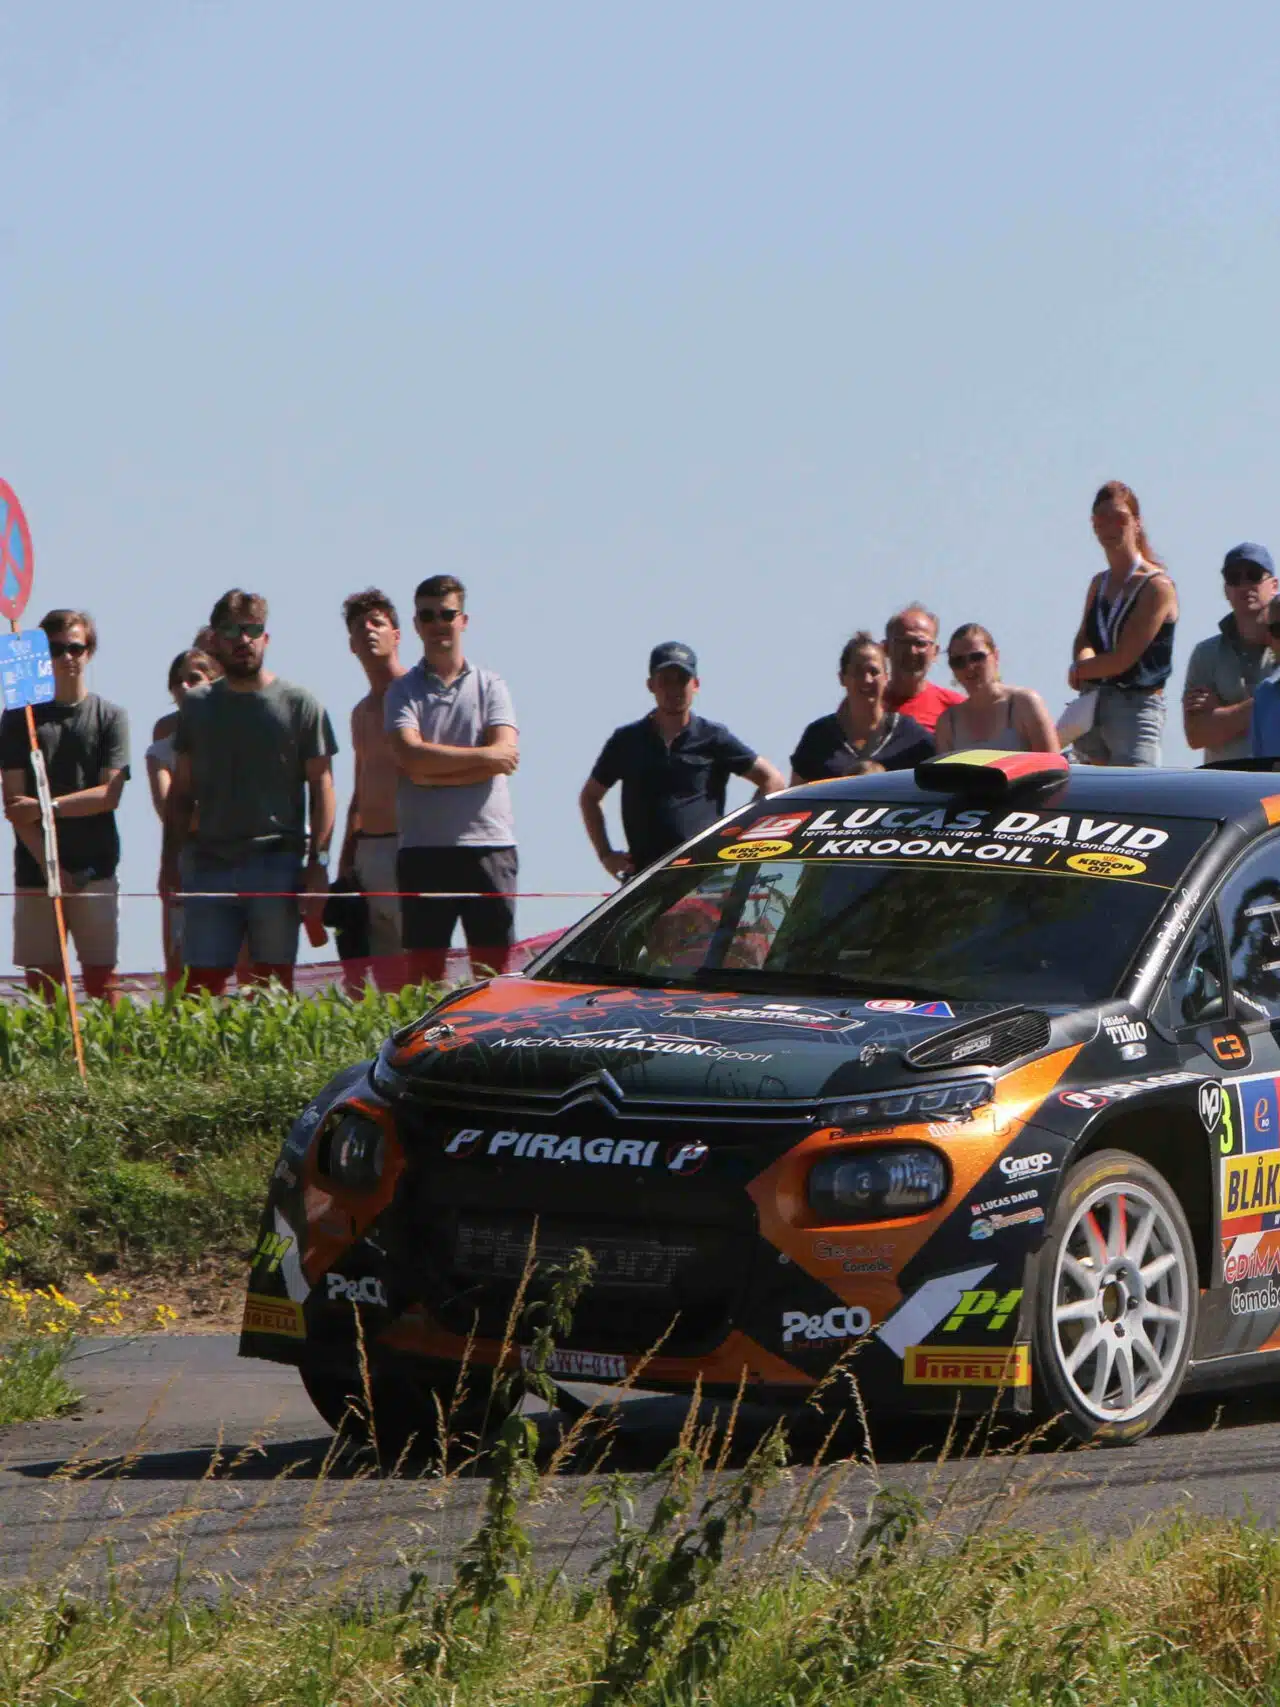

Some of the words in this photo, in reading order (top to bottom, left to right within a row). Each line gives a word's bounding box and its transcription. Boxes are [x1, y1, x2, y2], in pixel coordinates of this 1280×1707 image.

[806, 807, 991, 830] LUCAS
[993, 811, 1169, 850] DAVID
[728, 845, 781, 855] KROON
[736, 851, 760, 859] OIL
[801, 828, 896, 838] terrassement
[994, 832, 1049, 845] location
[1053, 837, 1070, 847] de
[1072, 841, 1150, 858] containers
[816, 839, 1033, 863] KROON-OIL
[1076, 858, 1135, 871] KROON
[1087, 866, 1111, 874] OIL
[1105, 1021, 1148, 1044] TIMO
[1212, 1034, 1246, 1061] C3
[1219, 1087, 1234, 1154] 3
[487, 1130, 660, 1167] PIRAGRI
[999, 1152, 1053, 1174] Cargo
[981, 1196, 1011, 1212] LUCAS
[1011, 1189, 1039, 1204] DAVID
[245, 1302, 298, 1331] IRELLI
[782, 1306, 871, 1342] P&CO
